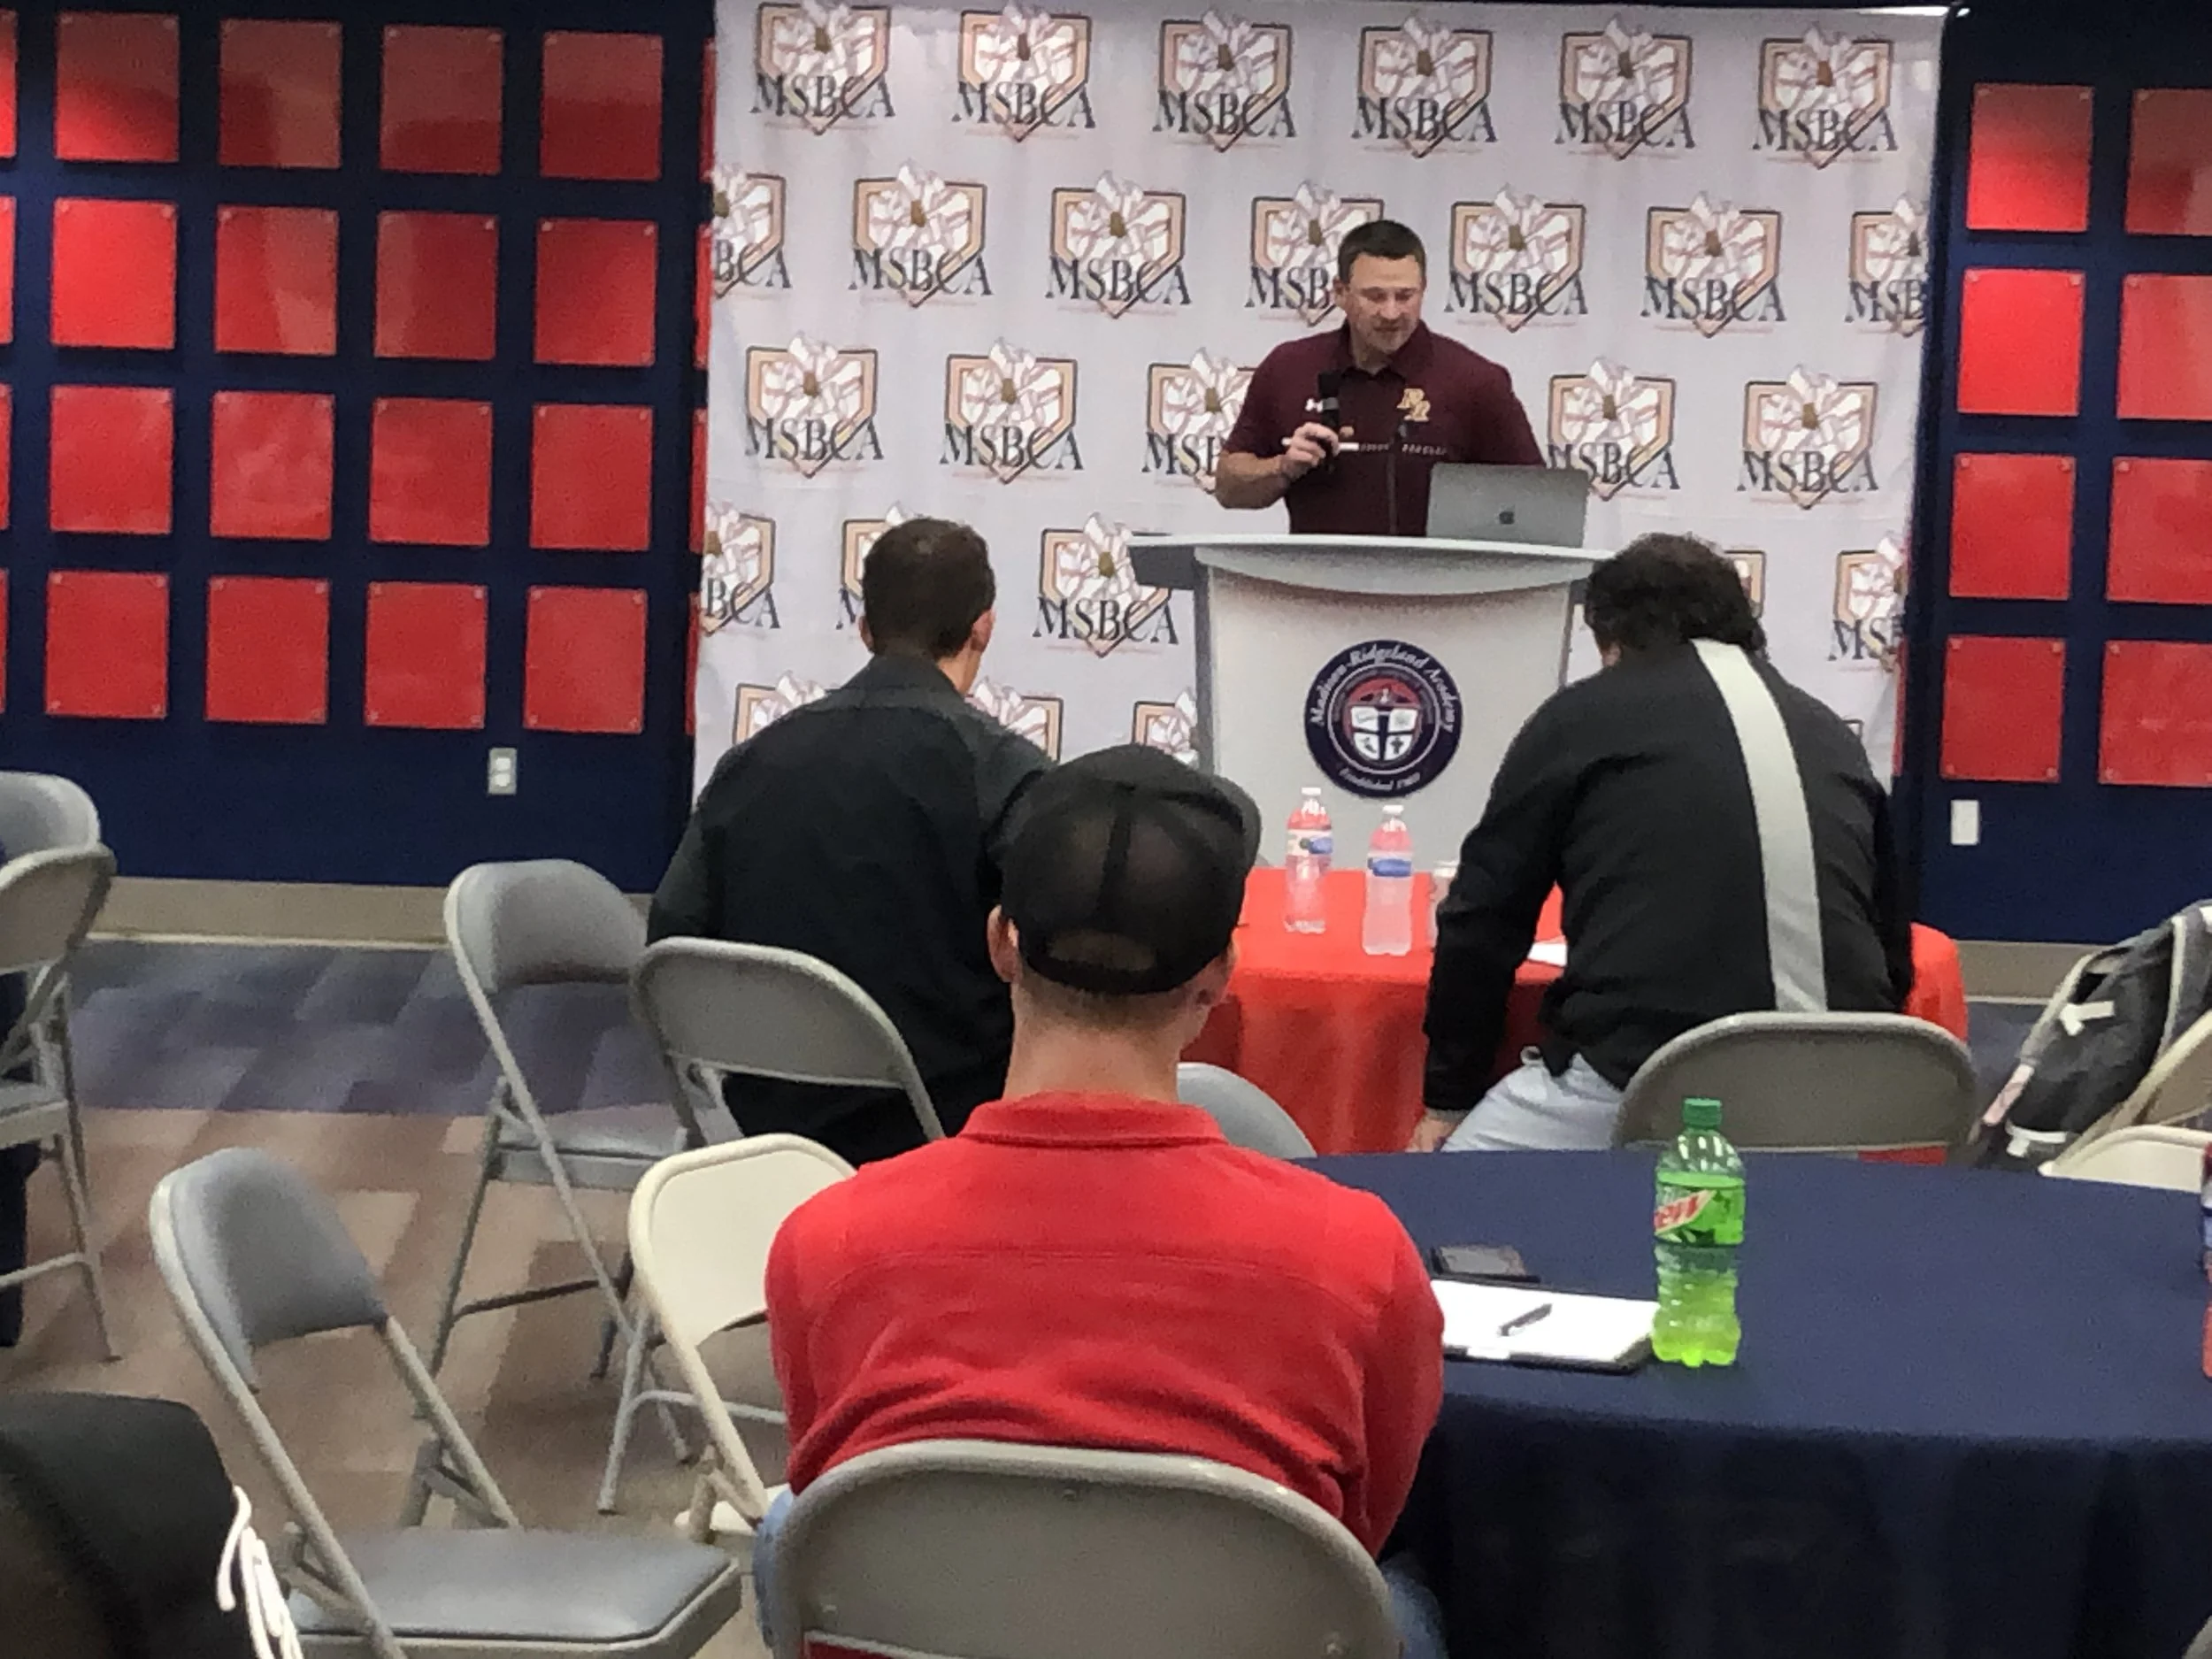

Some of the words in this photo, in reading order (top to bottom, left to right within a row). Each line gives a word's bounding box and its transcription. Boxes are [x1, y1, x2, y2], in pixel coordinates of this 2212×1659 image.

[749, 74, 895, 118] MSBCA
[951, 82, 1095, 128] MSBCA
[1153, 91, 1296, 138] MSBCA
[1352, 97, 1497, 143] MSBCA
[1555, 103, 1695, 149] MSBCA
[1752, 109, 1898, 151] MSBCA
[713, 239, 793, 288] BCA
[849, 249, 993, 296] MSBCA
[1045, 257, 1191, 305] MSBCA
[1244, 266, 1330, 310] MSB
[1445, 271, 1589, 316] MSBCA
[1641, 277, 1787, 321] MSBCA
[1844, 279, 1924, 323] MSB
[743, 417, 884, 461] MSBCA
[940, 423, 1084, 471] MSBCA
[1737, 450, 1878, 493] MSBCA
[706, 577, 780, 629] BCA
[1033, 597, 1179, 646] MSBCA
